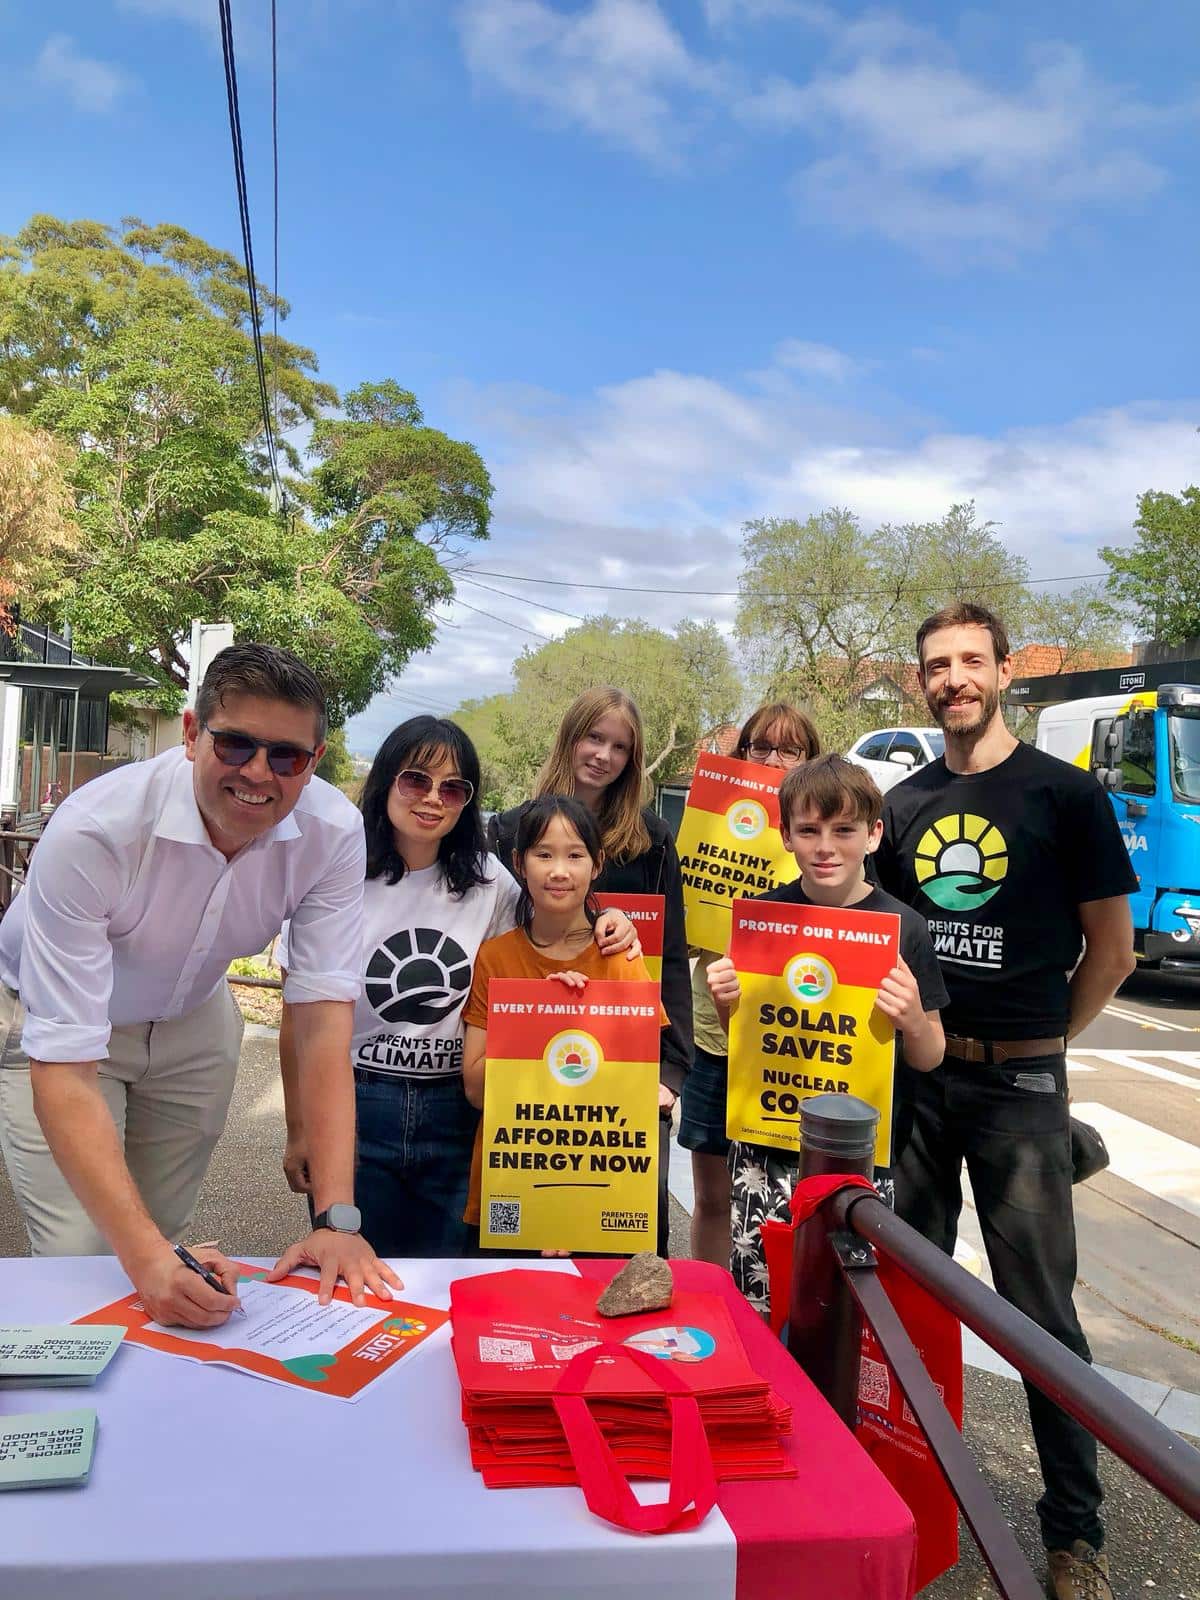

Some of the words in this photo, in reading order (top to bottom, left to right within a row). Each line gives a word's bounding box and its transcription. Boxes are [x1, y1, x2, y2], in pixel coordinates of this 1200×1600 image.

[1121, 675, 1143, 685] STONE
[698, 769, 728, 782] EVERY
[729, 777, 766, 792] FAMILY
[1122, 834, 1149, 851] MA
[697, 842, 776, 876] HEALTHY,
[681, 873, 739, 898] NERGY
[629, 911, 659, 921] MILY
[738, 919, 799, 936] PROTECT
[802, 925, 834, 940] OUR
[837, 928, 892, 946] FAMILY
[927, 919, 970, 936] RENTS
[972, 924, 1004, 939] FOR
[934, 934, 1004, 961] MATE
[493, 1003, 533, 1015] EVERY
[537, 1004, 586, 1016] FAMILY
[589, 1005, 655, 1017] DESERVES
[759, 1003, 857, 1038] SOLAR
[434, 1038, 463, 1051] FOR
[761, 1031, 853, 1066] SAVES
[358, 1043, 463, 1069] CLIMATE
[762, 1069, 850, 1093] NUCLEAR
[515, 1104, 628, 1127] HEALTHY,
[493, 1128, 647, 1148] AFFORDABLE
[489, 1151, 584, 1171] ENERGY
[590, 1155, 651, 1173] NOW
[601, 1211, 633, 1219] PARENTS
[601, 1219, 648, 1229] CLIMATE
[356, 1333, 401, 1362] LOVE
[1, 1439, 38, 1448] CLIN
[3, 1428, 84, 1440] CHATSWOOD
[47, 1435, 83, 1444] CARE
[26, 1448, 80, 1458] JEROME
[36, 1441, 82, 1451] BUILD
